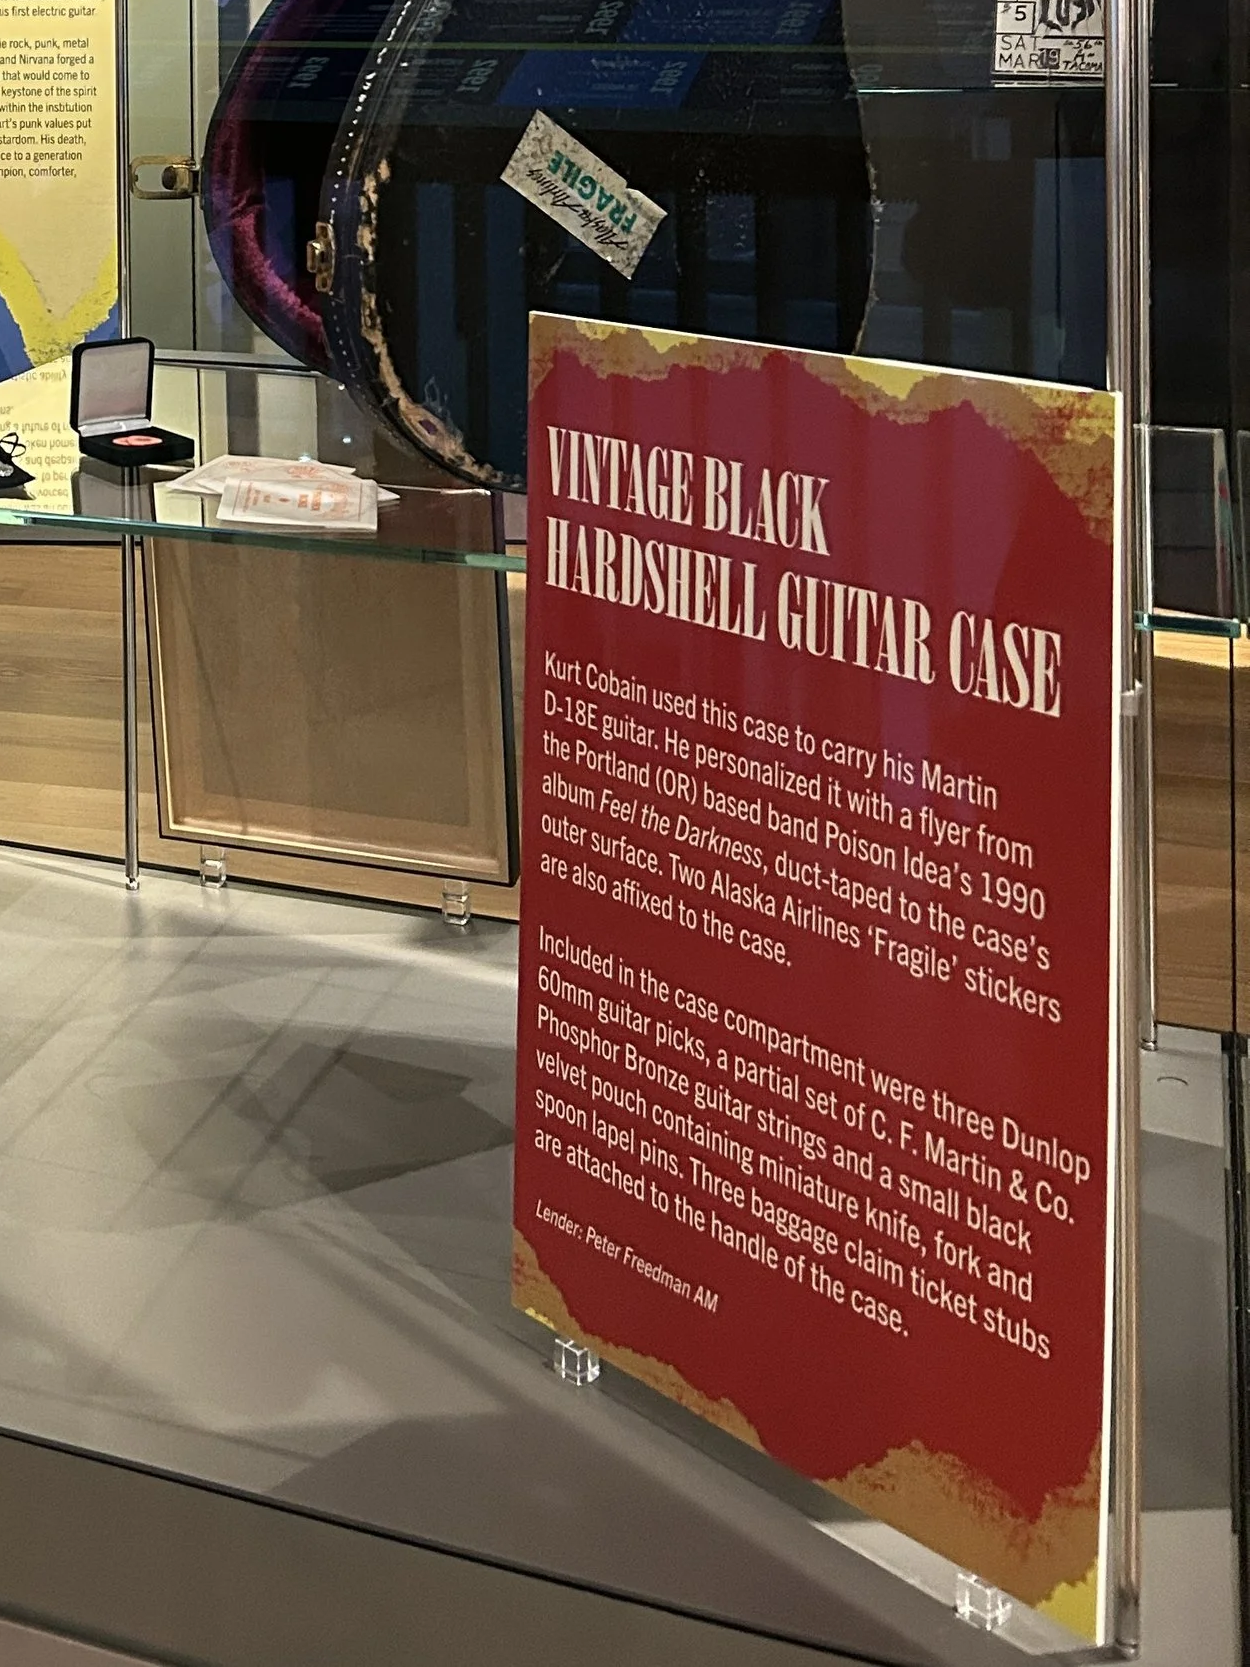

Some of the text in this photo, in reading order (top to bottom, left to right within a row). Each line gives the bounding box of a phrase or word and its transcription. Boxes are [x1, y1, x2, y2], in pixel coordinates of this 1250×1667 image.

[1001, 35, 1043, 51] SAT
[547, 149, 638, 236] FRAGILE
[545, 424, 831, 557] VINTAGE BLACK
[544, 514, 1061, 719] HARDSHELL GUITAR CASE
[543, 688, 1033, 870] D-18E guitar. He personalized it with a flyer from
[544, 649, 998, 811] Kurt Cobain used this case to carry his Martin
[541, 728, 571, 762] the
[574, 738, 650, 788] Portland
[654, 764, 697, 806] (OR)
[702, 779, 762, 826] based
[766, 800, 818, 845] band
[824, 819, 896, 871] Poison
[980, 870, 1046, 921] 1990
[541, 770, 595, 811] album
[598, 787, 638, 824] Feel
[639, 802, 671, 836] the
[673, 813, 768, 876] Darkness,
[773, 849, 892, 915] duct-taped
[897, 890, 922, 925] to
[926, 900, 966, 941] the
[539, 852, 792, 967] are also affixed to the case.
[540, 812, 588, 847] outer
[589, 830, 663, 876] surface.
[667, 851, 706, 891] Two
[709, 868, 776, 918] Alaska
[780, 893, 861, 949] Airlines
[963, 964, 1062, 1024] stickers
[534, 1197, 719, 1313] Lender: Peter Freedman AM
